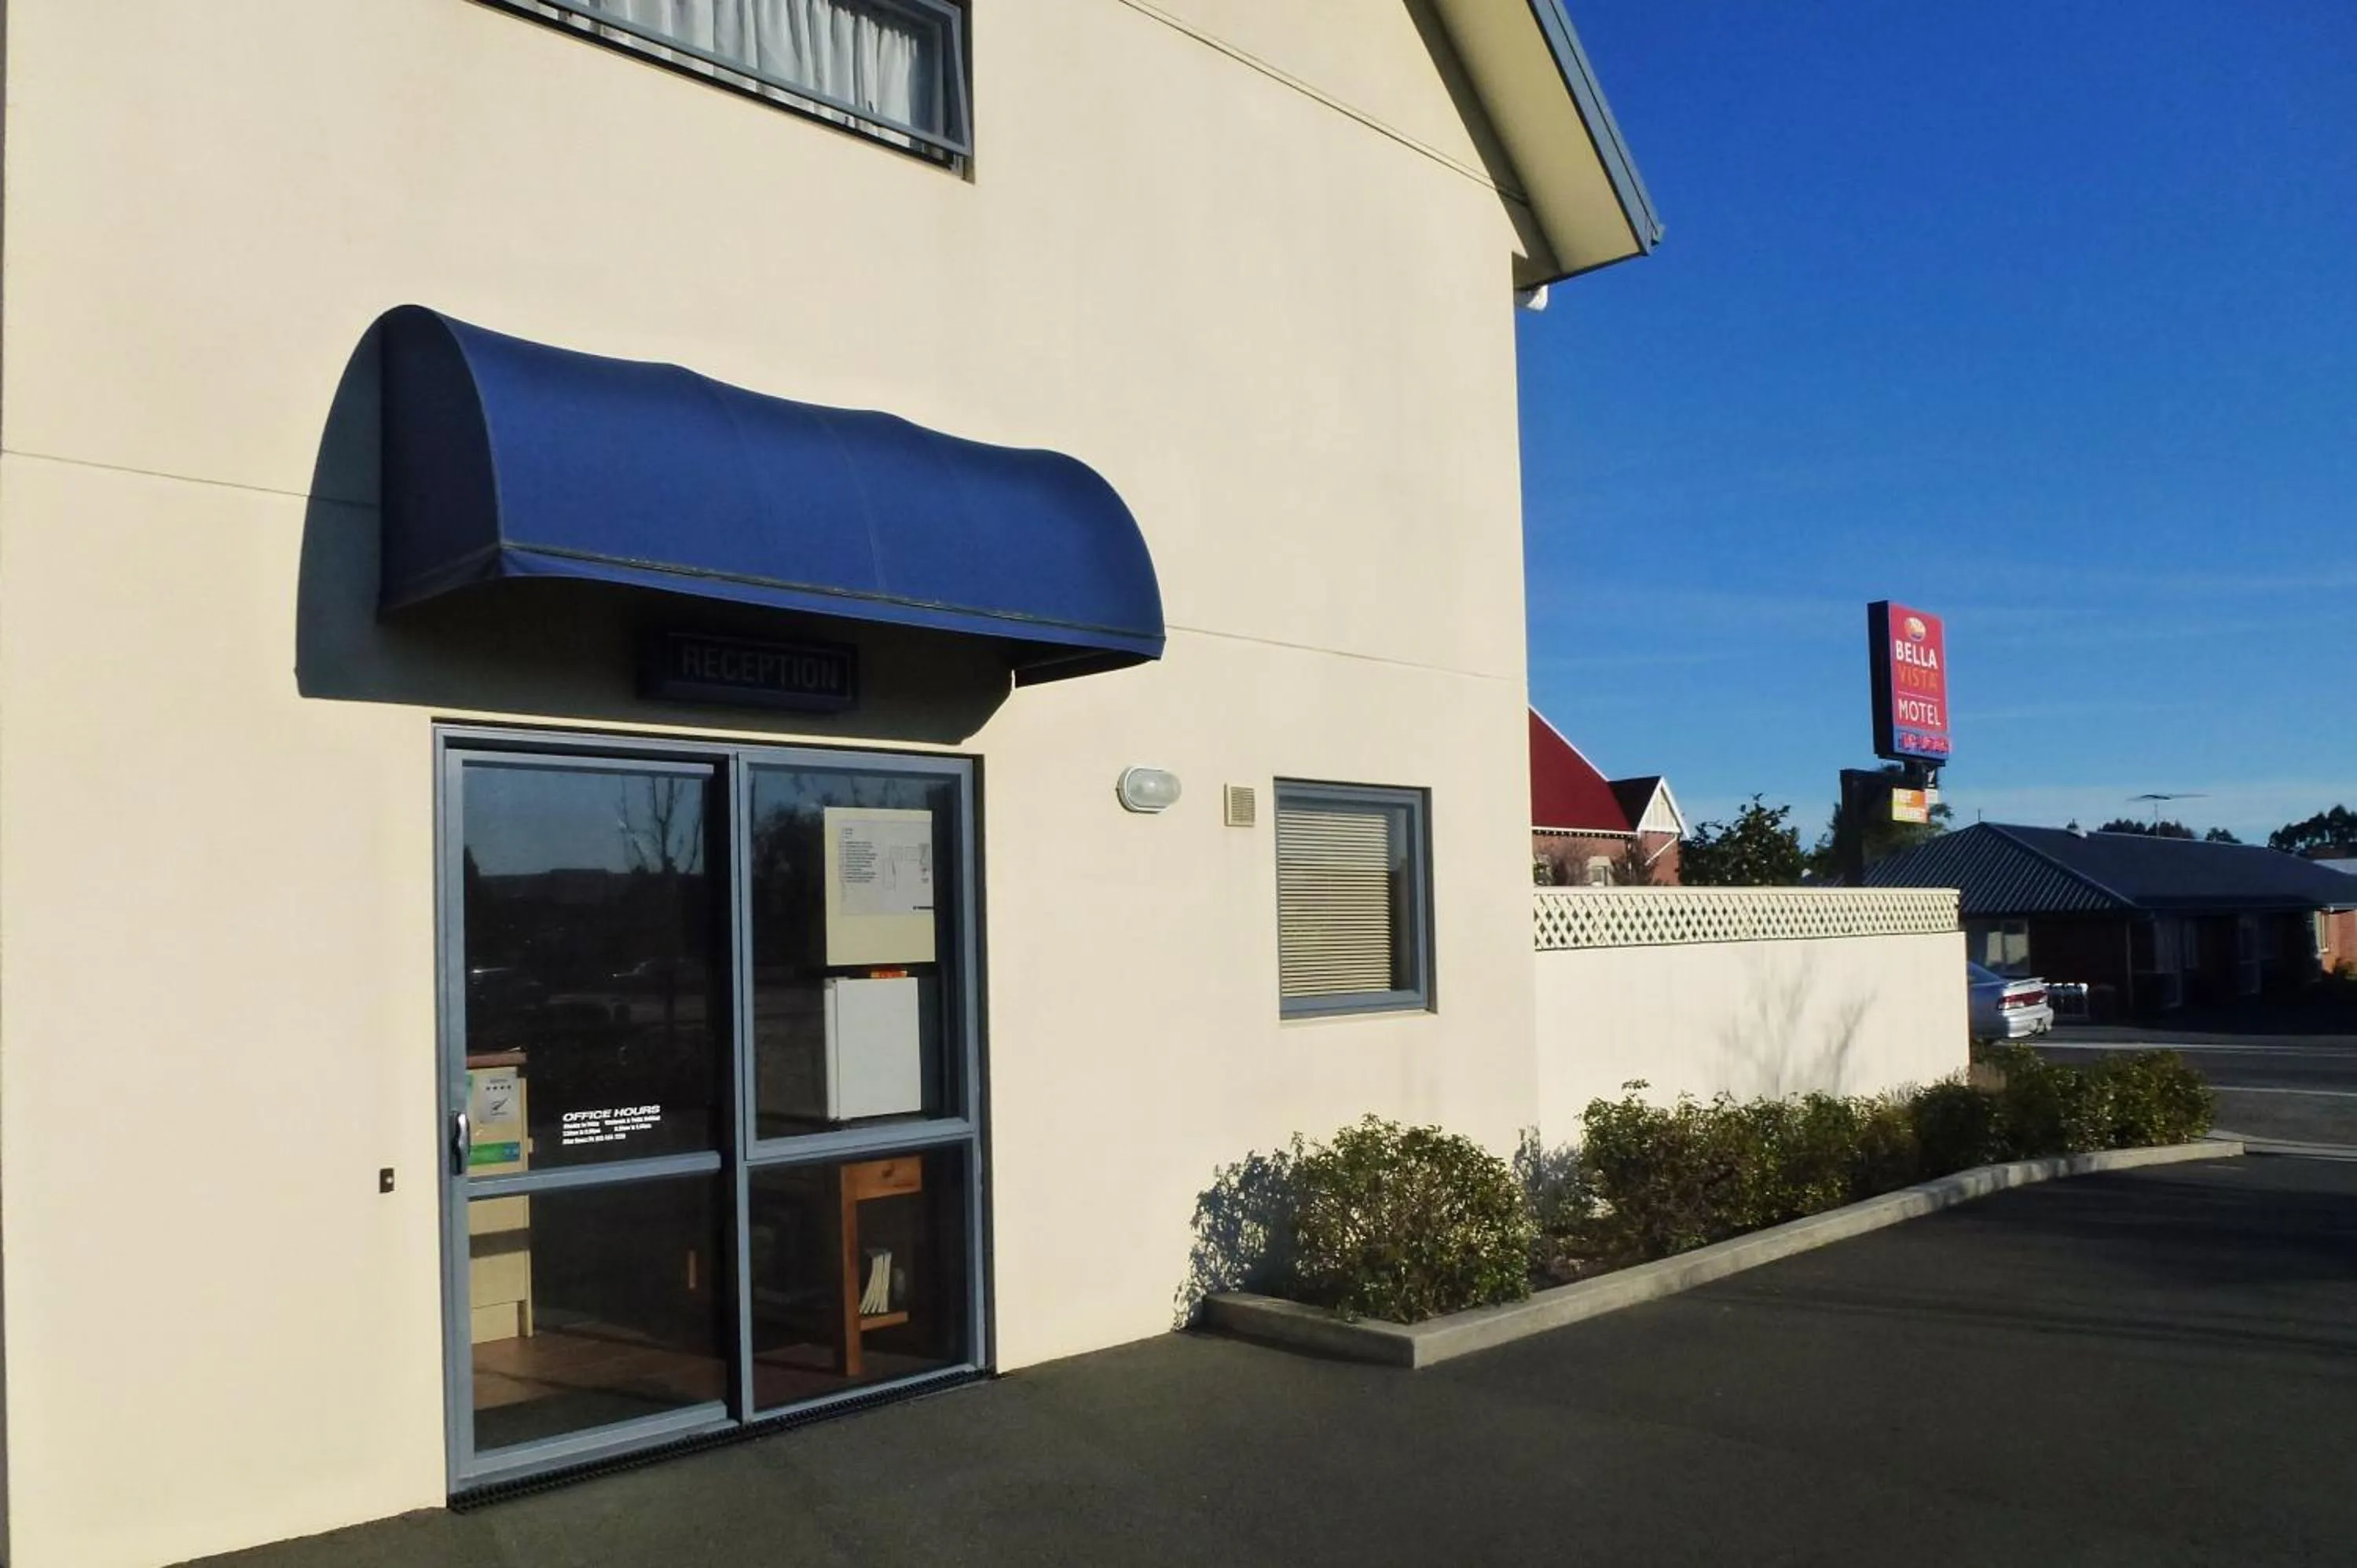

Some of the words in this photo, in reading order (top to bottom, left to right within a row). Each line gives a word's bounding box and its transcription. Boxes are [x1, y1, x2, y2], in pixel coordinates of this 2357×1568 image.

[681, 643, 838, 690] RECEPTION
[1895, 639, 1938, 669] BELLA
[1898, 665, 1939, 692] VISTA
[1897, 698, 1942, 726] MOTEL
[563, 1109, 612, 1122] OFFICE
[614, 1105, 660, 1117] HOURS
